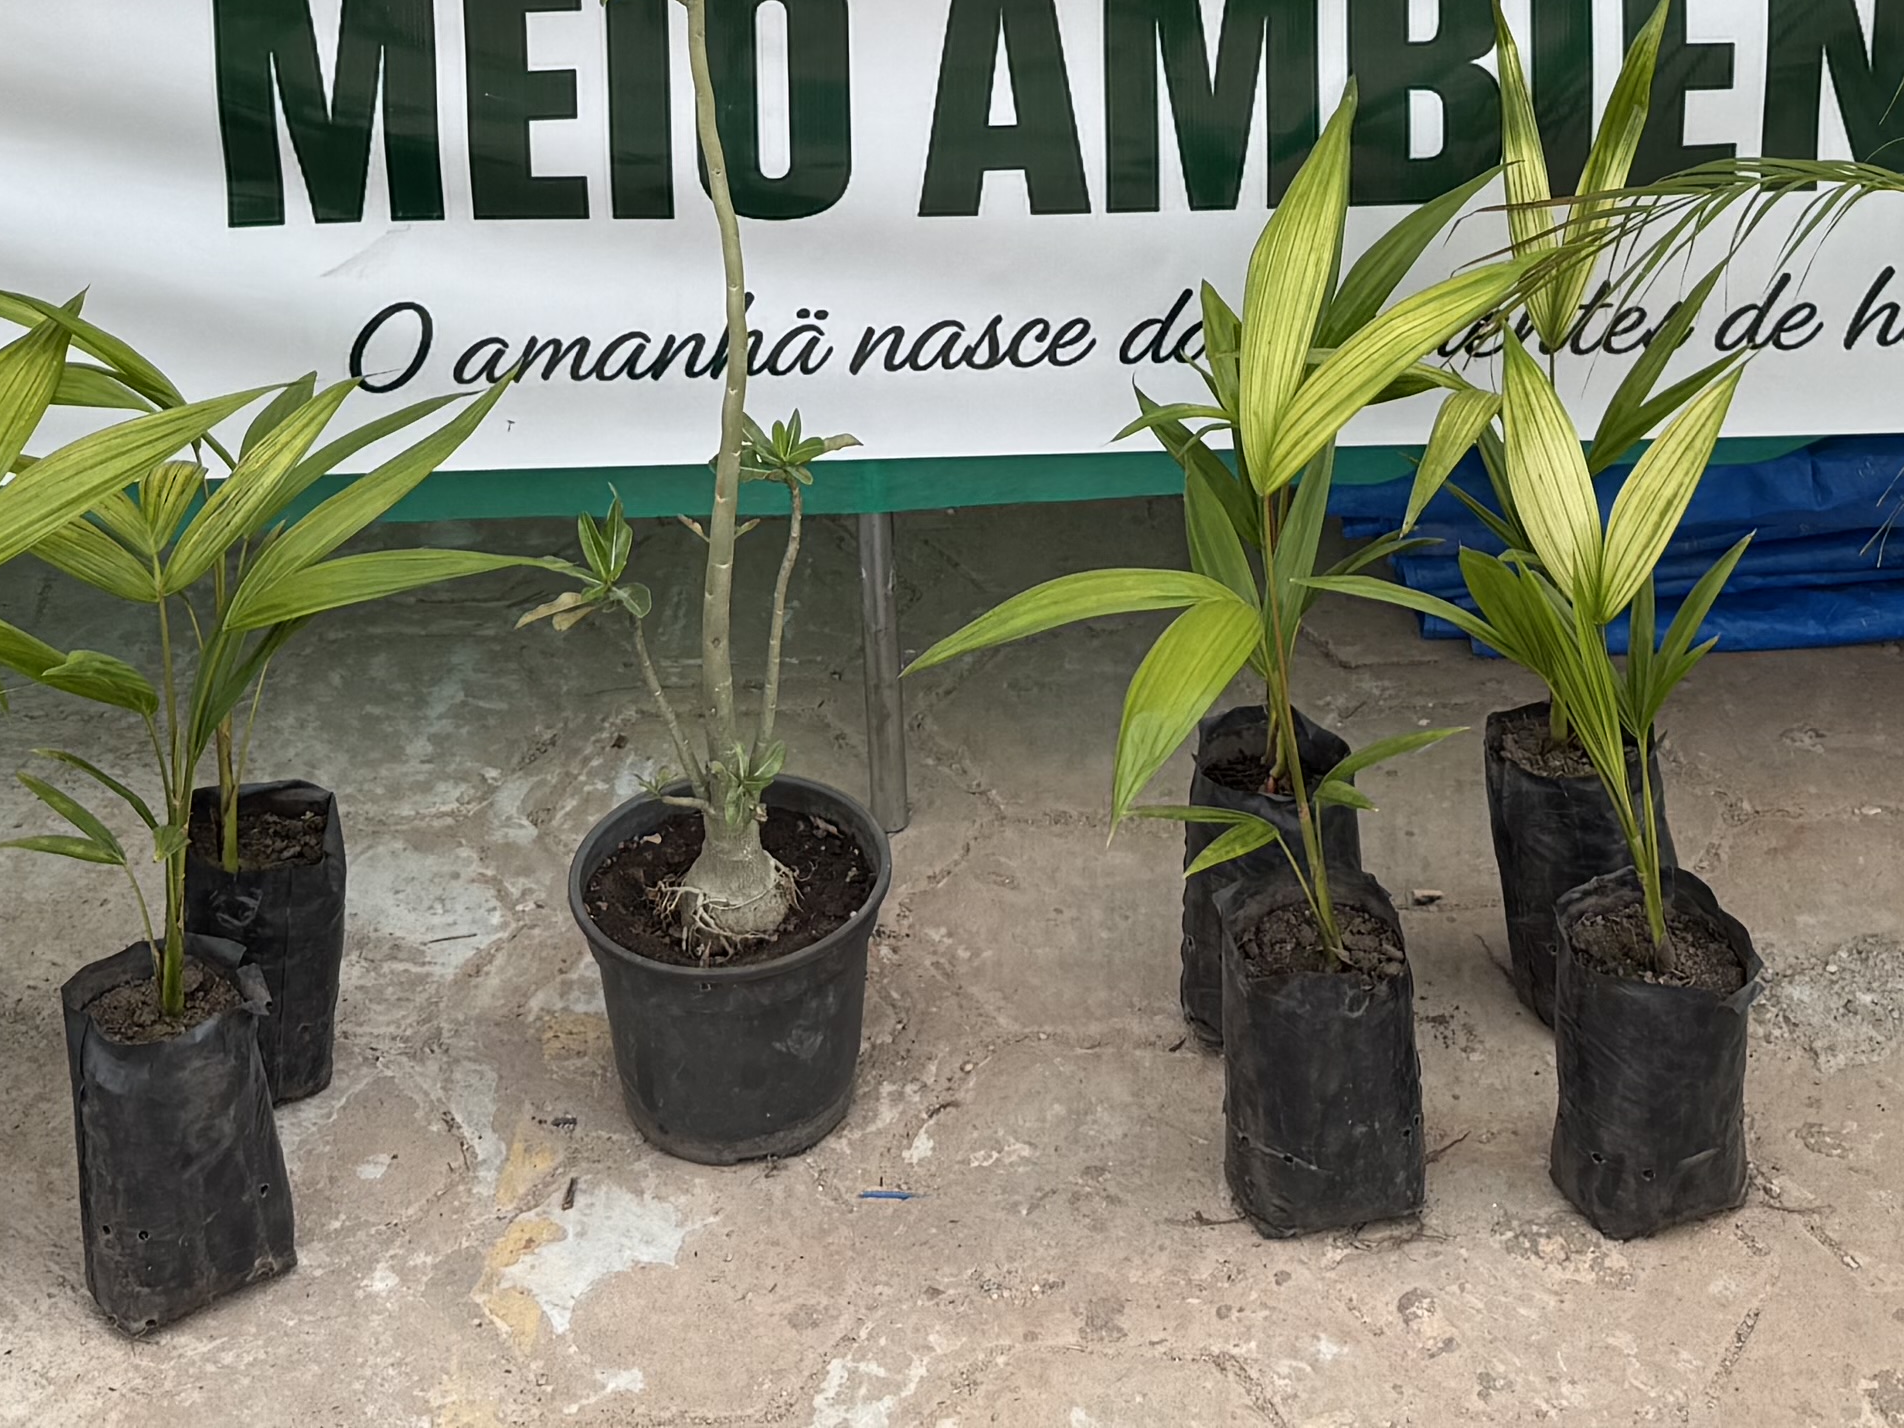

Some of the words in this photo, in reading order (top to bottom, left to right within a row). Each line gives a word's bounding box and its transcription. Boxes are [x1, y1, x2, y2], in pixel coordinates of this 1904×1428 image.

[348, 300, 433, 394] O
[849, 314, 1097, 376] nasce
[1714, 272, 1825, 352] de
